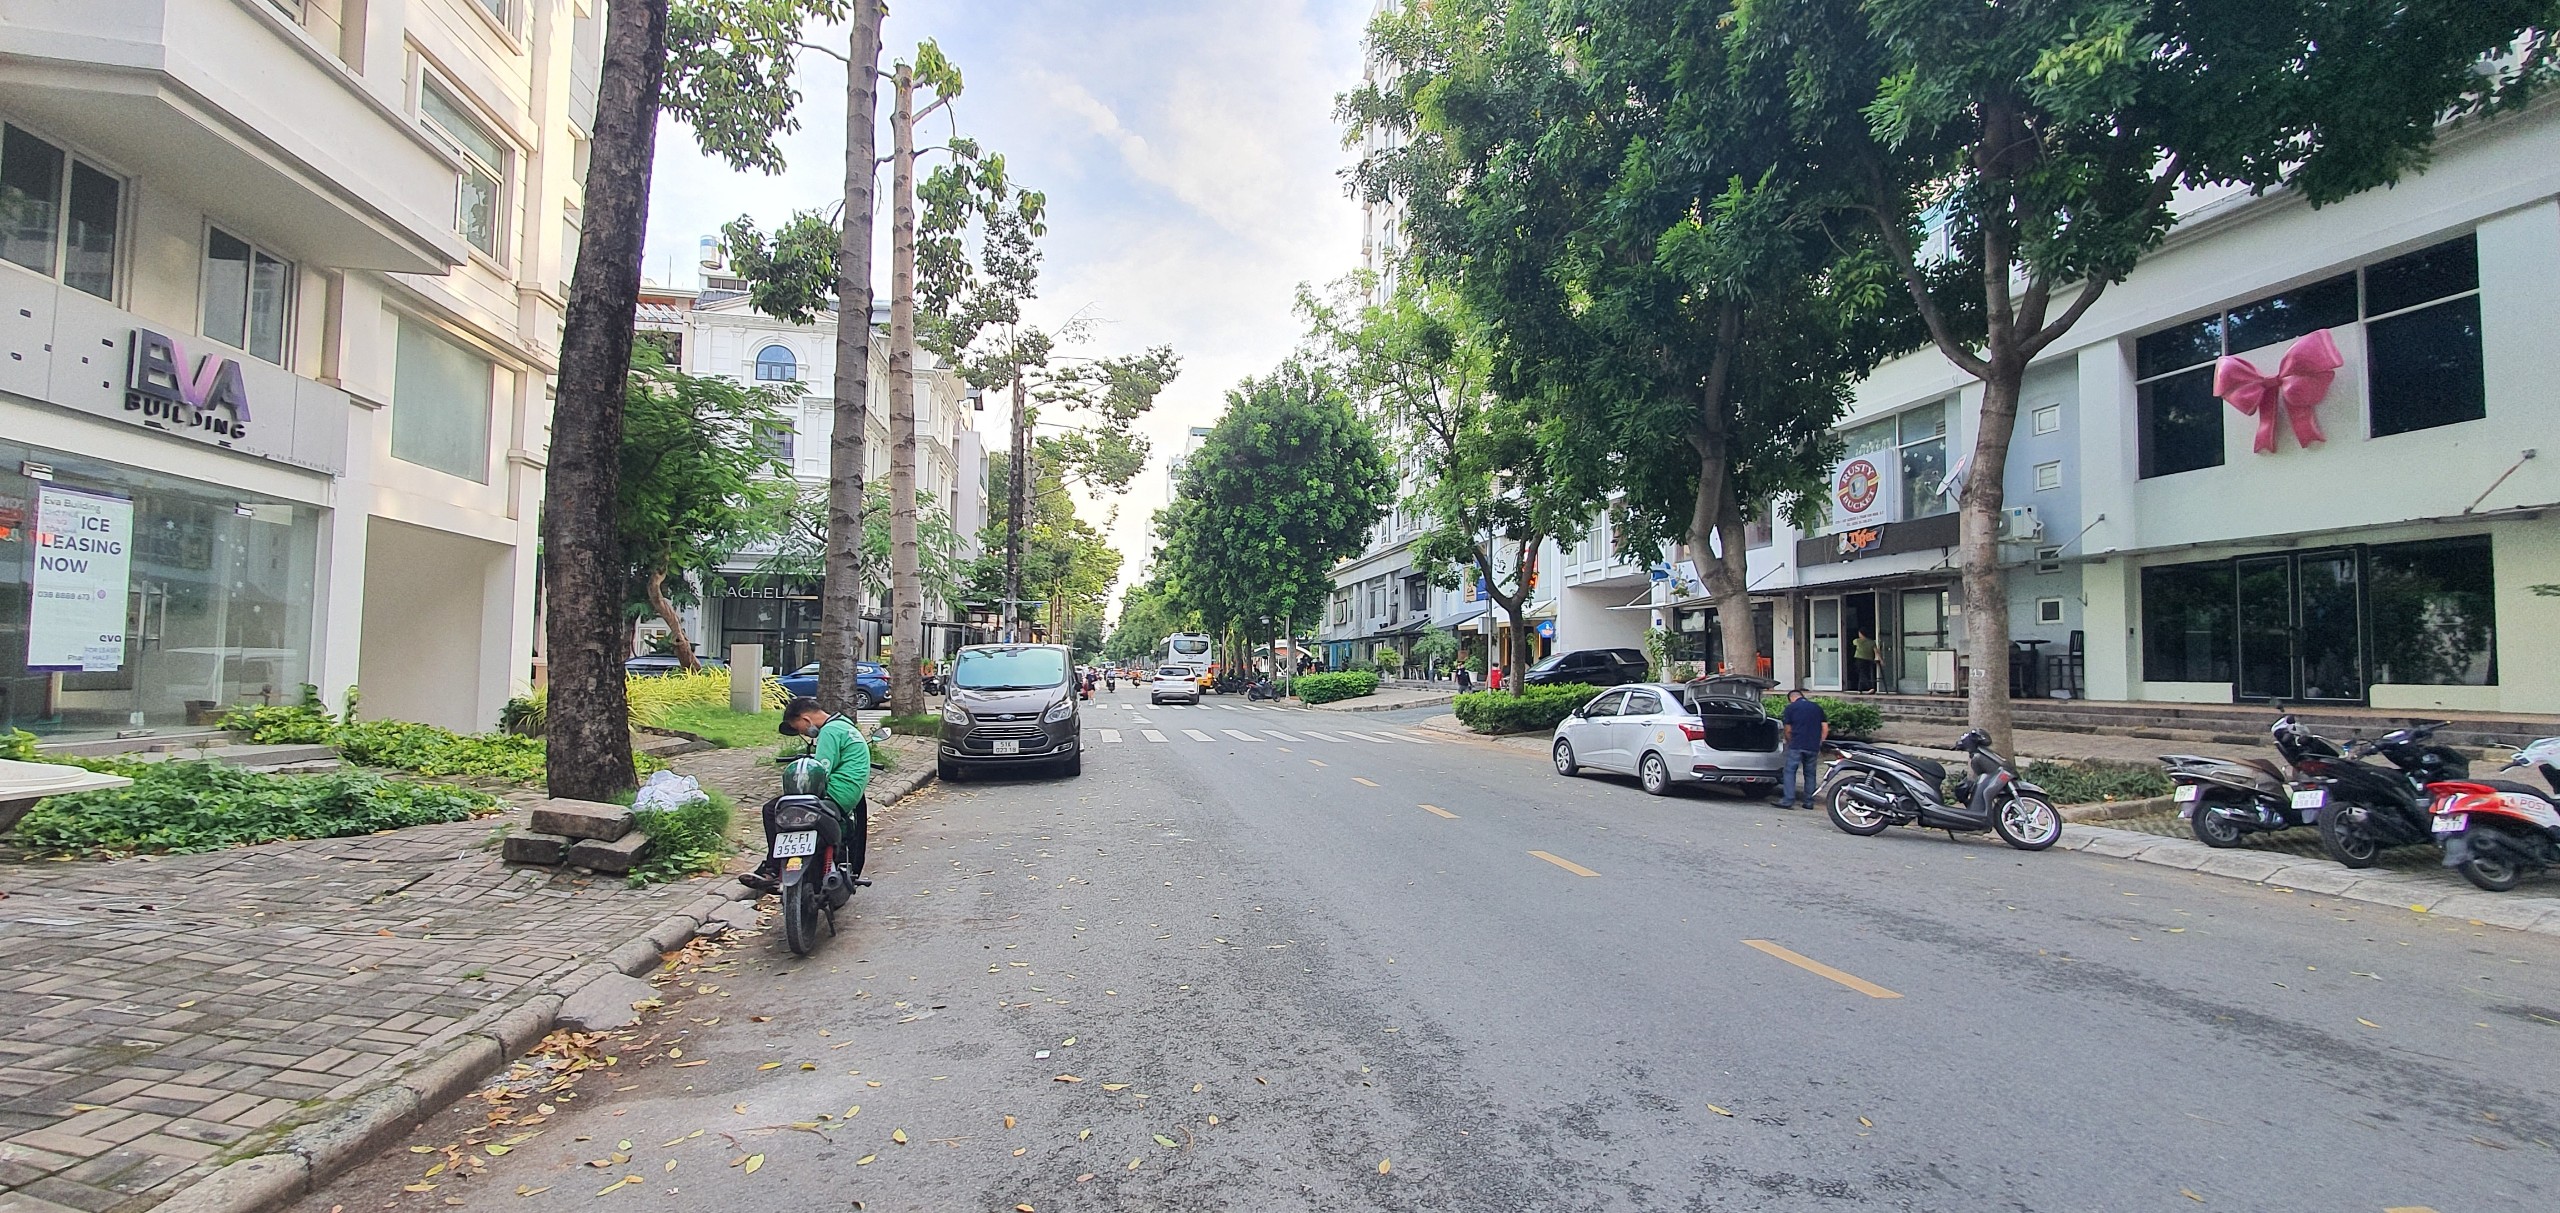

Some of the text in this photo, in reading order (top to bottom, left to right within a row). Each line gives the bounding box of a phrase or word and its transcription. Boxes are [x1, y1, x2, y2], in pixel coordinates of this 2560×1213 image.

[128, 328, 251, 422] EVA
[125, 393, 245, 439] BUILDING
[1842, 463, 1874, 484] RUSTY
[44, 495, 61, 506] Eva
[64, 499, 101, 515] Building
[1842, 488, 1875, 510] BUCKET
[81, 516, 110, 532] ICE
[41, 533, 122, 555] LEASING
[1849, 528, 1877, 548] Tiger
[40, 555, 88, 573] NOW
[99, 634, 122, 643] eva
[2520, 798, 2546, 811] POST
[782, 833, 810, 845] 74-F1
[776, 844, 812, 856] 355.54
